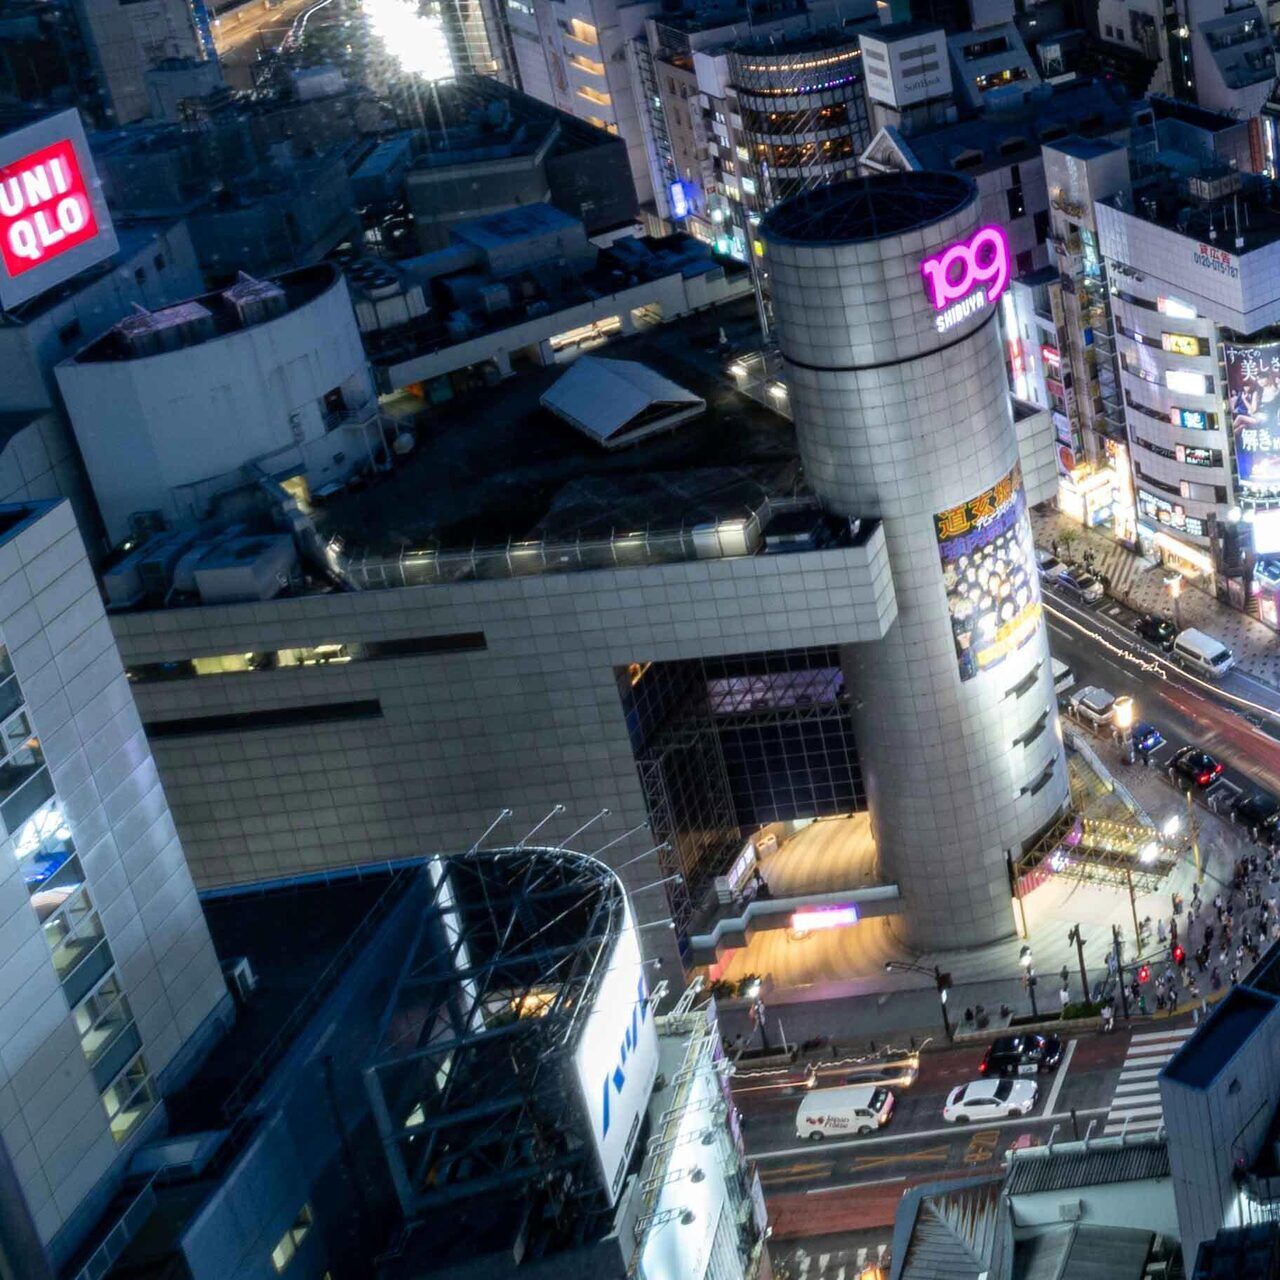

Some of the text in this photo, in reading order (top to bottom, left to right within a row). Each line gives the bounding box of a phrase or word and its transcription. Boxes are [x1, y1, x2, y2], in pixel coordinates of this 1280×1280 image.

[1, 158, 67, 217] UNI
[8, 196, 83, 259] QLO
[923, 228, 1008, 309] 109
[935, 291, 985, 333] SHIBUYA
[1226, 347, 1261, 364] すべての
